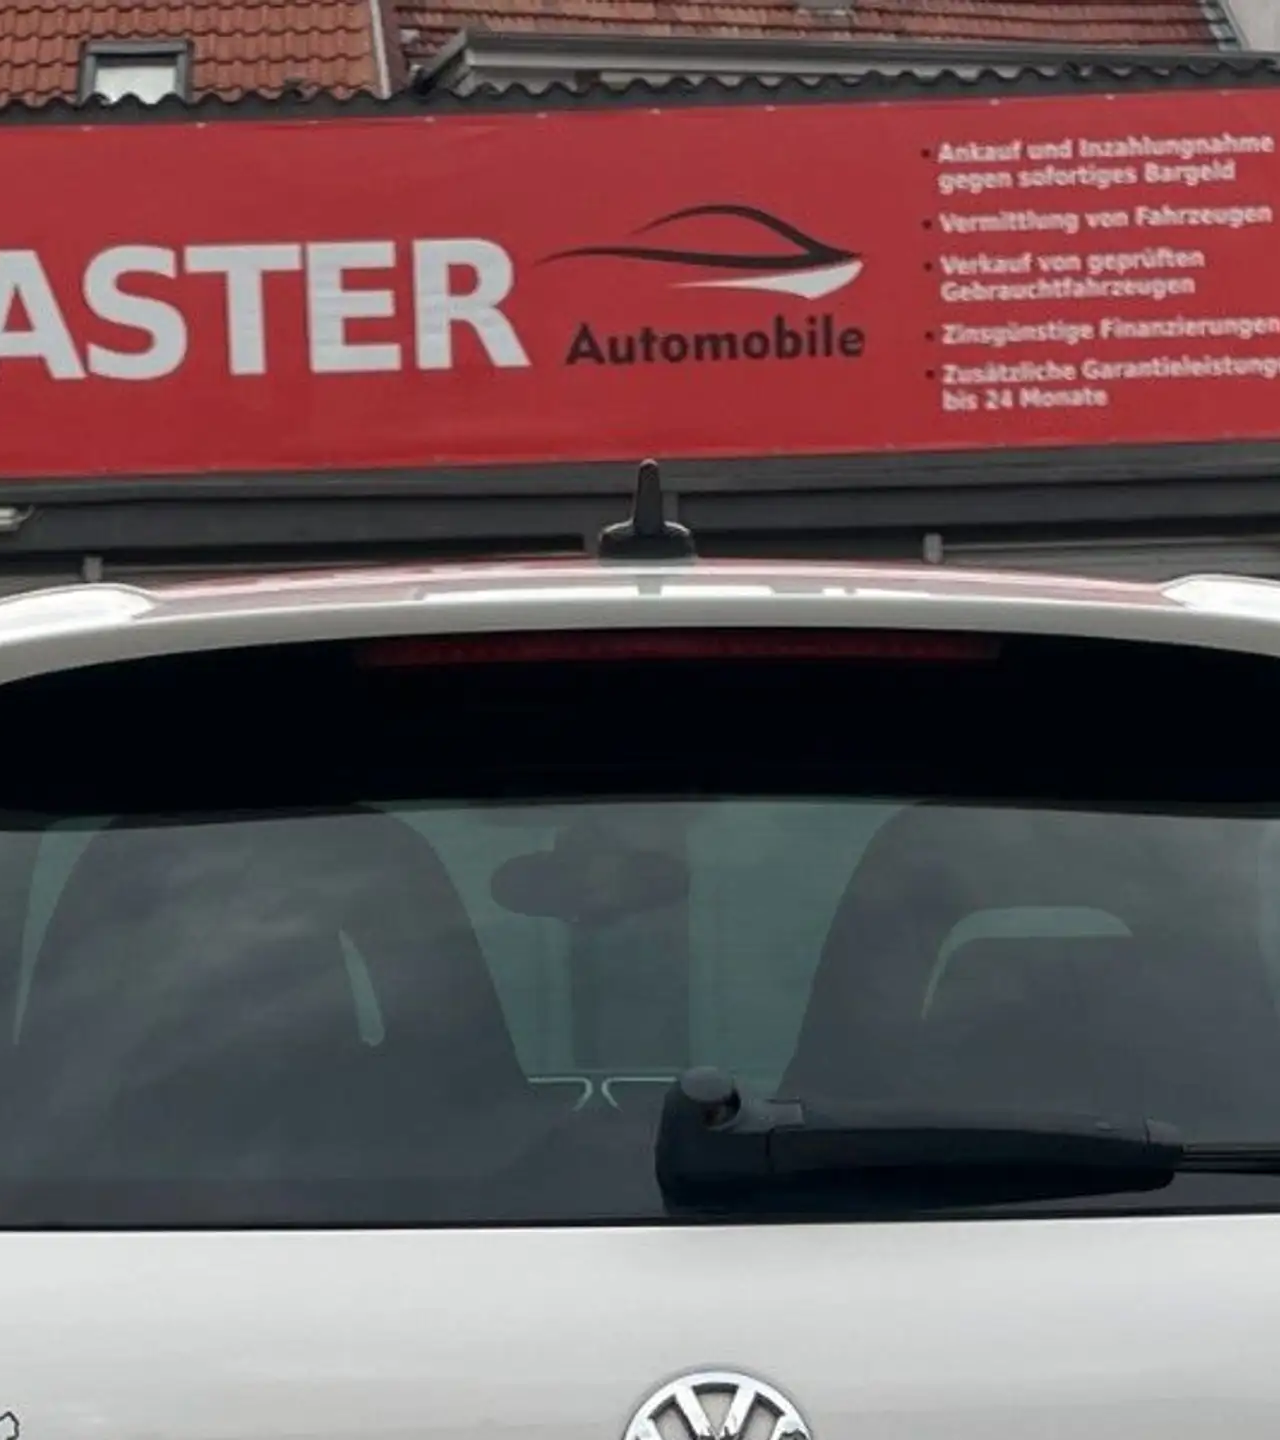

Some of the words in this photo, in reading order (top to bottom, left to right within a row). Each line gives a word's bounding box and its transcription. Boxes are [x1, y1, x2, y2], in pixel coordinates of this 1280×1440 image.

[938, 141, 1020, 163] Ankauf
[1027, 138, 1073, 159] und
[1079, 132, 1274, 160] Inzahlungnahme
[938, 172, 1013, 194] gegen
[1017, 163, 1138, 189] sofortiges
[1144, 158, 1236, 186] Bargeld
[939, 209, 1080, 234] Vermittlung
[1085, 211, 1129, 228] von
[1134, 204, 1274, 228] Fahrzeugen
[940, 252, 1032, 274] Verkauf
[1037, 255, 1081, 272] von
[1086, 247, 1205, 276] geprüften
[940, 277, 1196, 302] Gebrauchtfahrzeugen
[565, 313, 865, 365] Automobile
[942, 320, 1095, 347] Zinsgünstige
[942, 360, 1077, 384] Zusätzliche
[942, 387, 979, 411] bis
[985, 389, 1013, 410] 24
[1020, 386, 1109, 409] Monate
